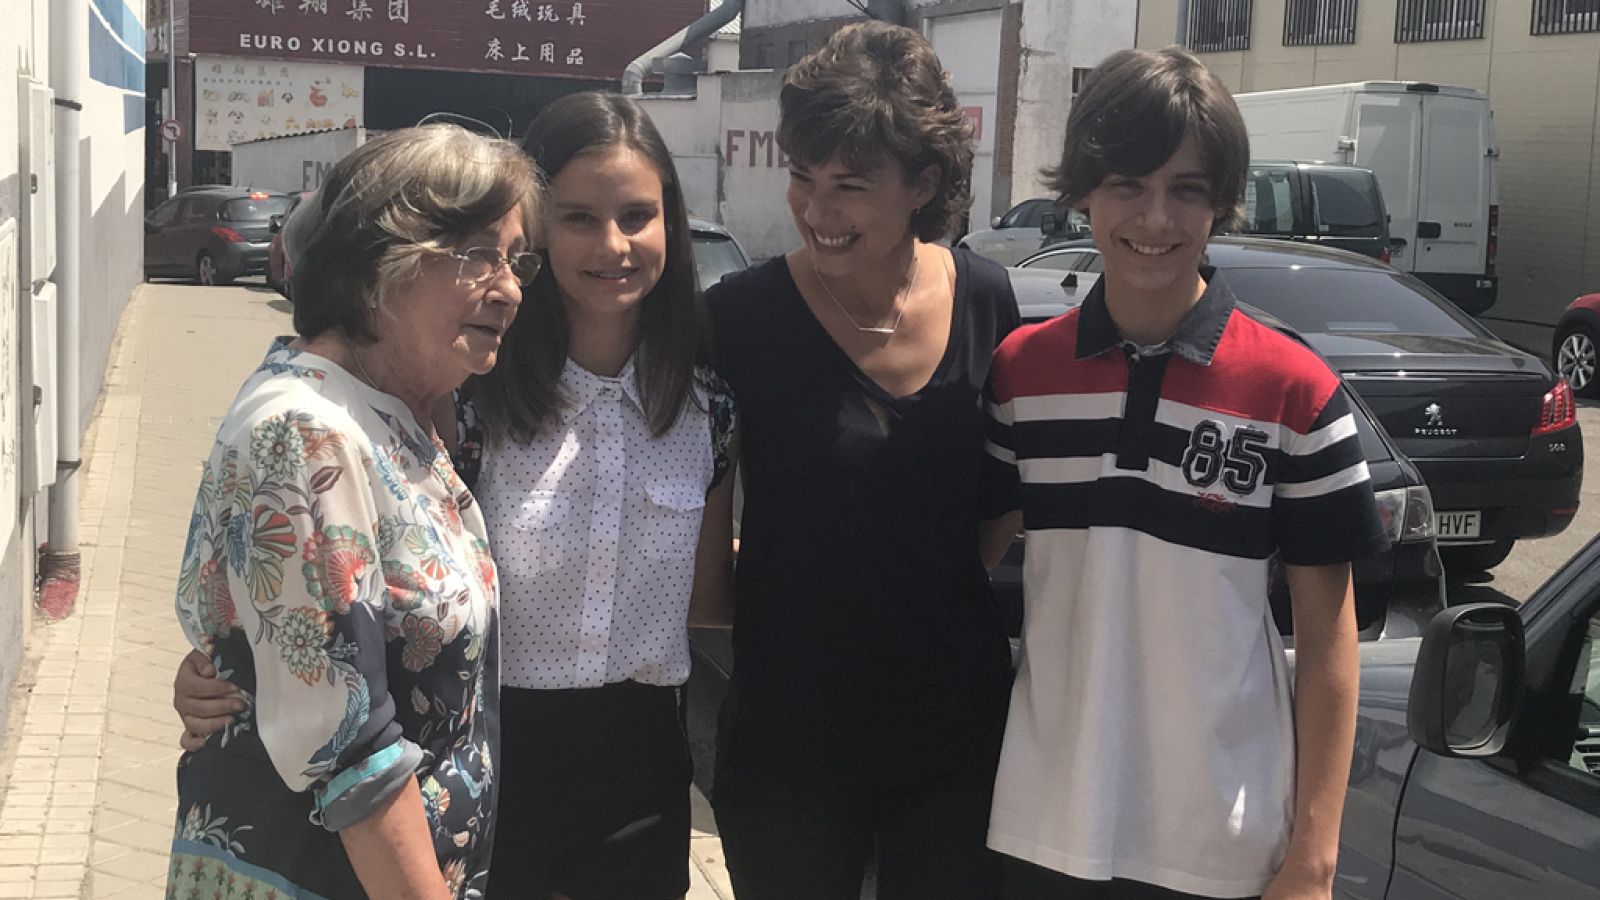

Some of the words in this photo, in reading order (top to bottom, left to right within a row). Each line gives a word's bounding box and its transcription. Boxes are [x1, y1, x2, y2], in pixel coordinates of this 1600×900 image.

[485, 0, 587, 25] 毛绒玩具
[239, 33, 300, 50] EURO
[312, 38, 384, 56] XIONG
[394, 43, 436, 58] S.L.
[485, 37, 584, 65] 床上用品
[1414, 427, 1458, 436] PEUGEOT
[1183, 419, 1269, 496] 85
[1439, 514, 1476, 535] HVF
